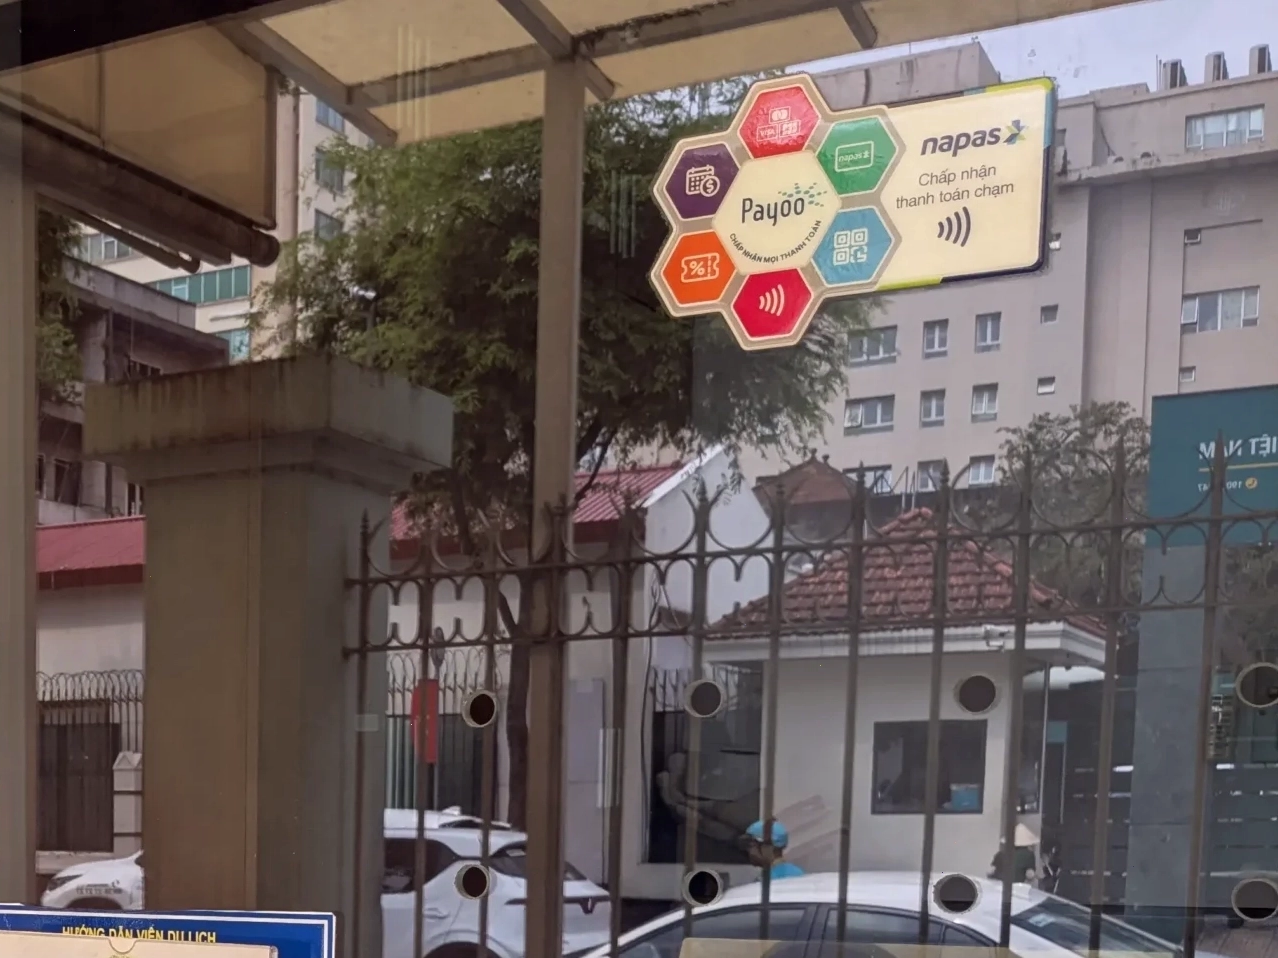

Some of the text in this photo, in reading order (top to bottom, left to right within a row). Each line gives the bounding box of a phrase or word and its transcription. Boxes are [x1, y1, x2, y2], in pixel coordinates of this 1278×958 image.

[920, 128, 1001, 157] napas
[919, 165, 996, 186] Chấp nhận
[896, 183, 1014, 208] thanh toán chạm
[742, 198, 804, 226] Payoo
[764, 256, 778, 264] MỌI
[780, 242, 806, 260] THANH
[805, 220, 821, 241] TOÁN
